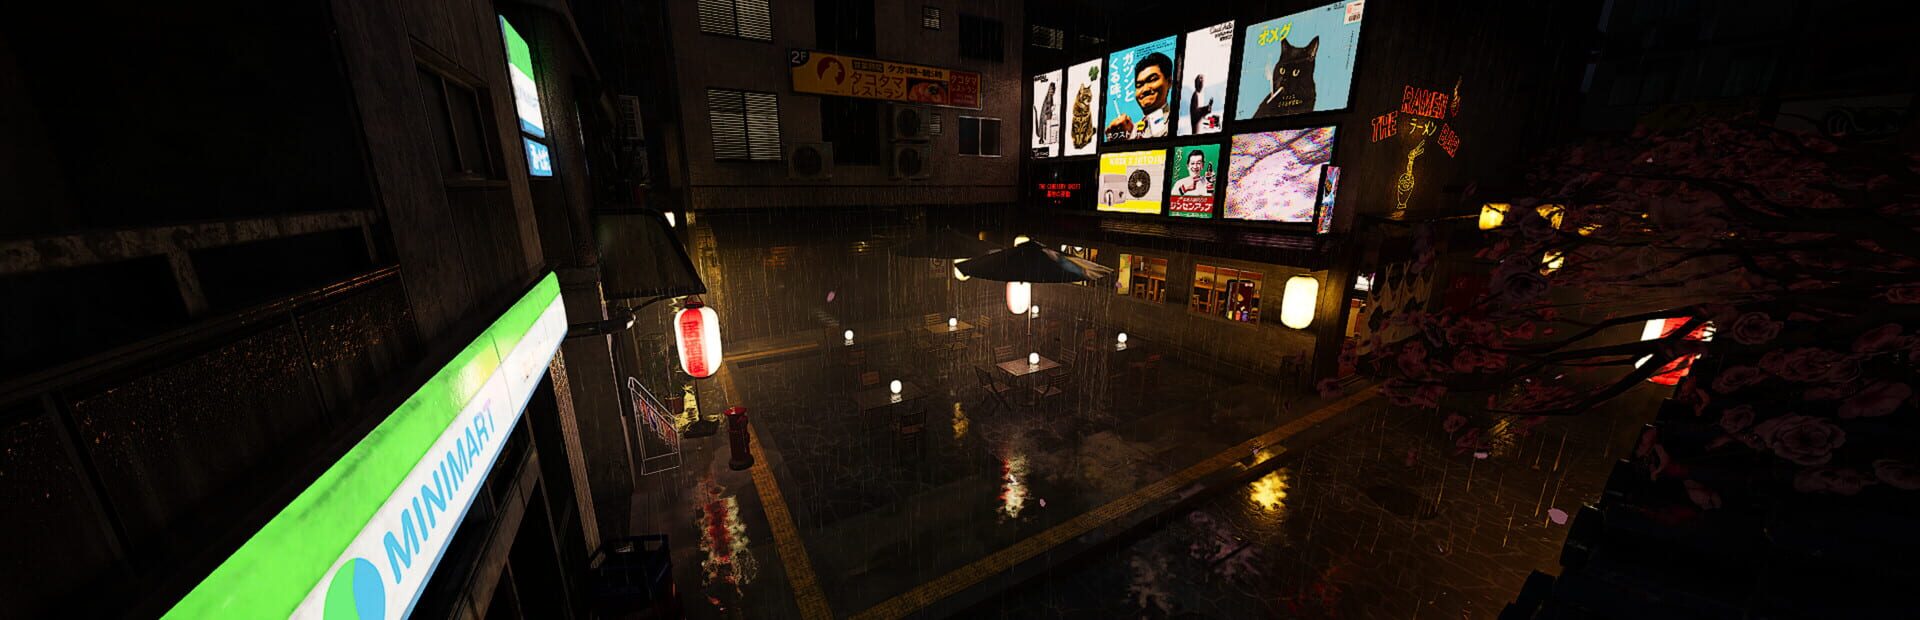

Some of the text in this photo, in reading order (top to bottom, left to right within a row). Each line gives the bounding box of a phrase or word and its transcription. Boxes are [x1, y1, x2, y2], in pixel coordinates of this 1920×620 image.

[791, 50, 807, 63] 2F
[850, 71, 904, 88] タコタマ
[1122, 51, 1135, 103] ガツンと
[850, 86, 904, 98] レストラン
[1400, 84, 1449, 120] RAMEN
[1371, 110, 1398, 143] THE
[1409, 118, 1437, 136] ラーメン
[1170, 201, 1213, 212] ジンセンアップ
[383, 399, 496, 585] MINIMART
